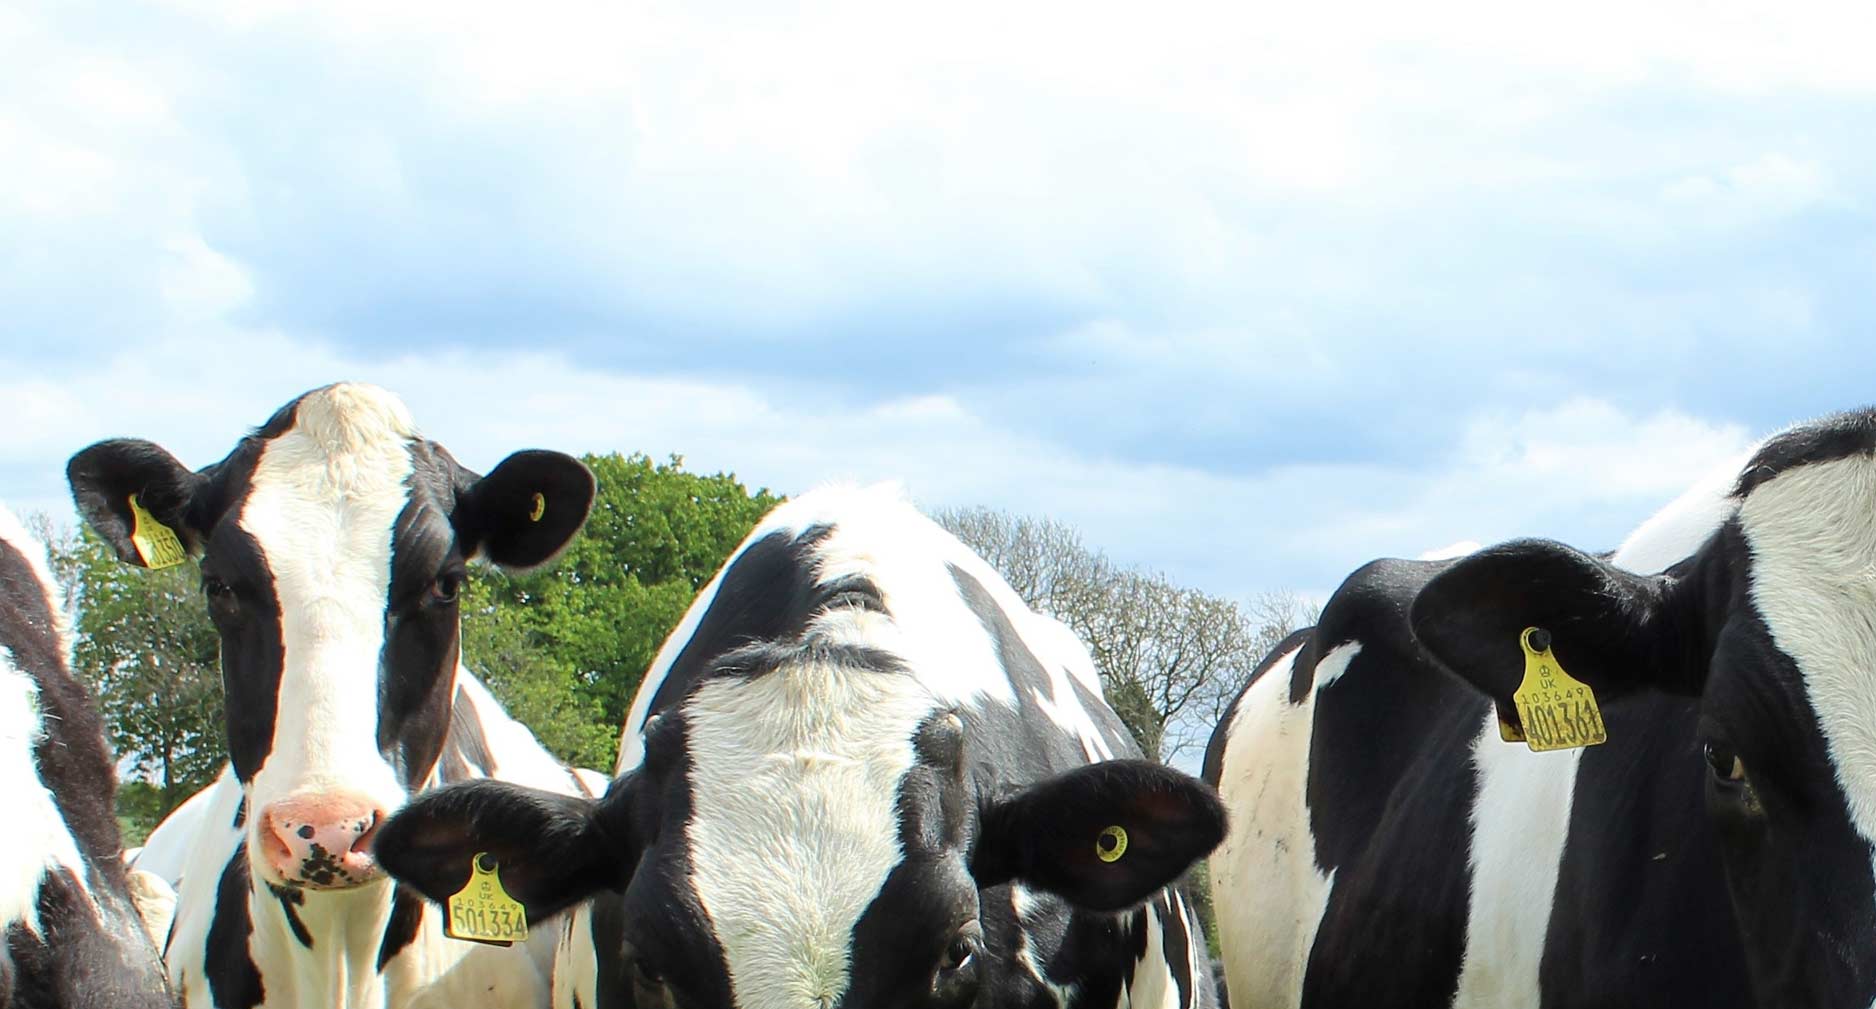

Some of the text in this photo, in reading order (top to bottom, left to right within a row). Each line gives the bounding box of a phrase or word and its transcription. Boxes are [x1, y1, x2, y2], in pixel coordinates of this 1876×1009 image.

[1540, 679, 1557, 689] UK
[1521, 687, 1584, 705] 103649
[1526, 699, 1605, 746] 401361
[456, 898, 517, 911] 103649
[453, 905, 526, 939] 501334
